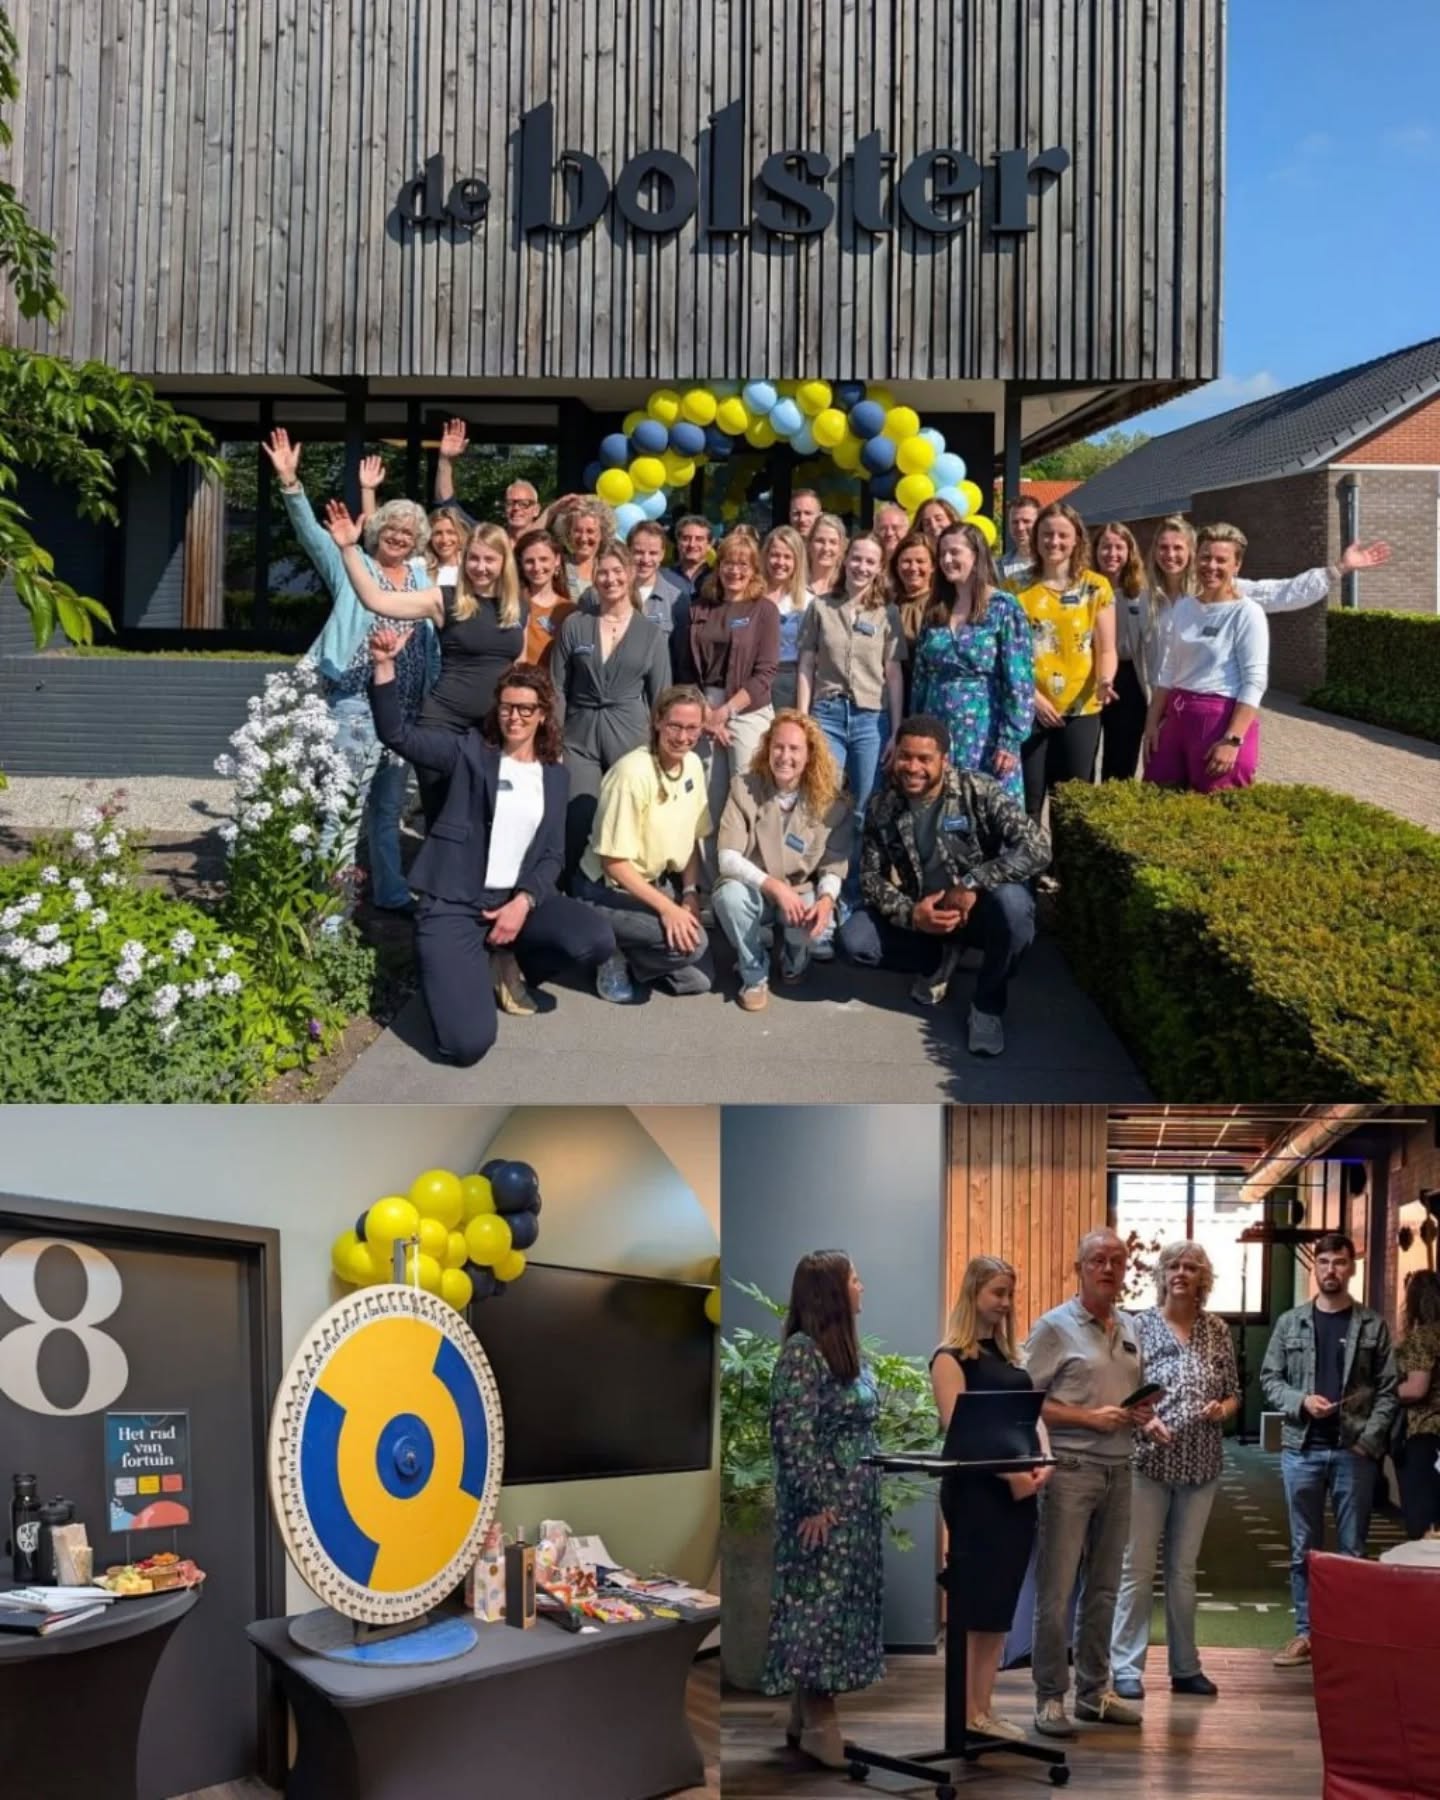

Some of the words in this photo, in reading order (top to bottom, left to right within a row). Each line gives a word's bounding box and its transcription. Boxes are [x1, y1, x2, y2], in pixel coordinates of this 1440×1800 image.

[399, 152, 491, 225] de
[519, 99, 1071, 235] bolster
[0, 1237, 128, 1416] 8
[118, 1427, 144, 1440] Het
[150, 1426, 176, 1439] rad
[134, 1443, 162, 1454] van
[121, 1452, 174, 1468] fortuin
